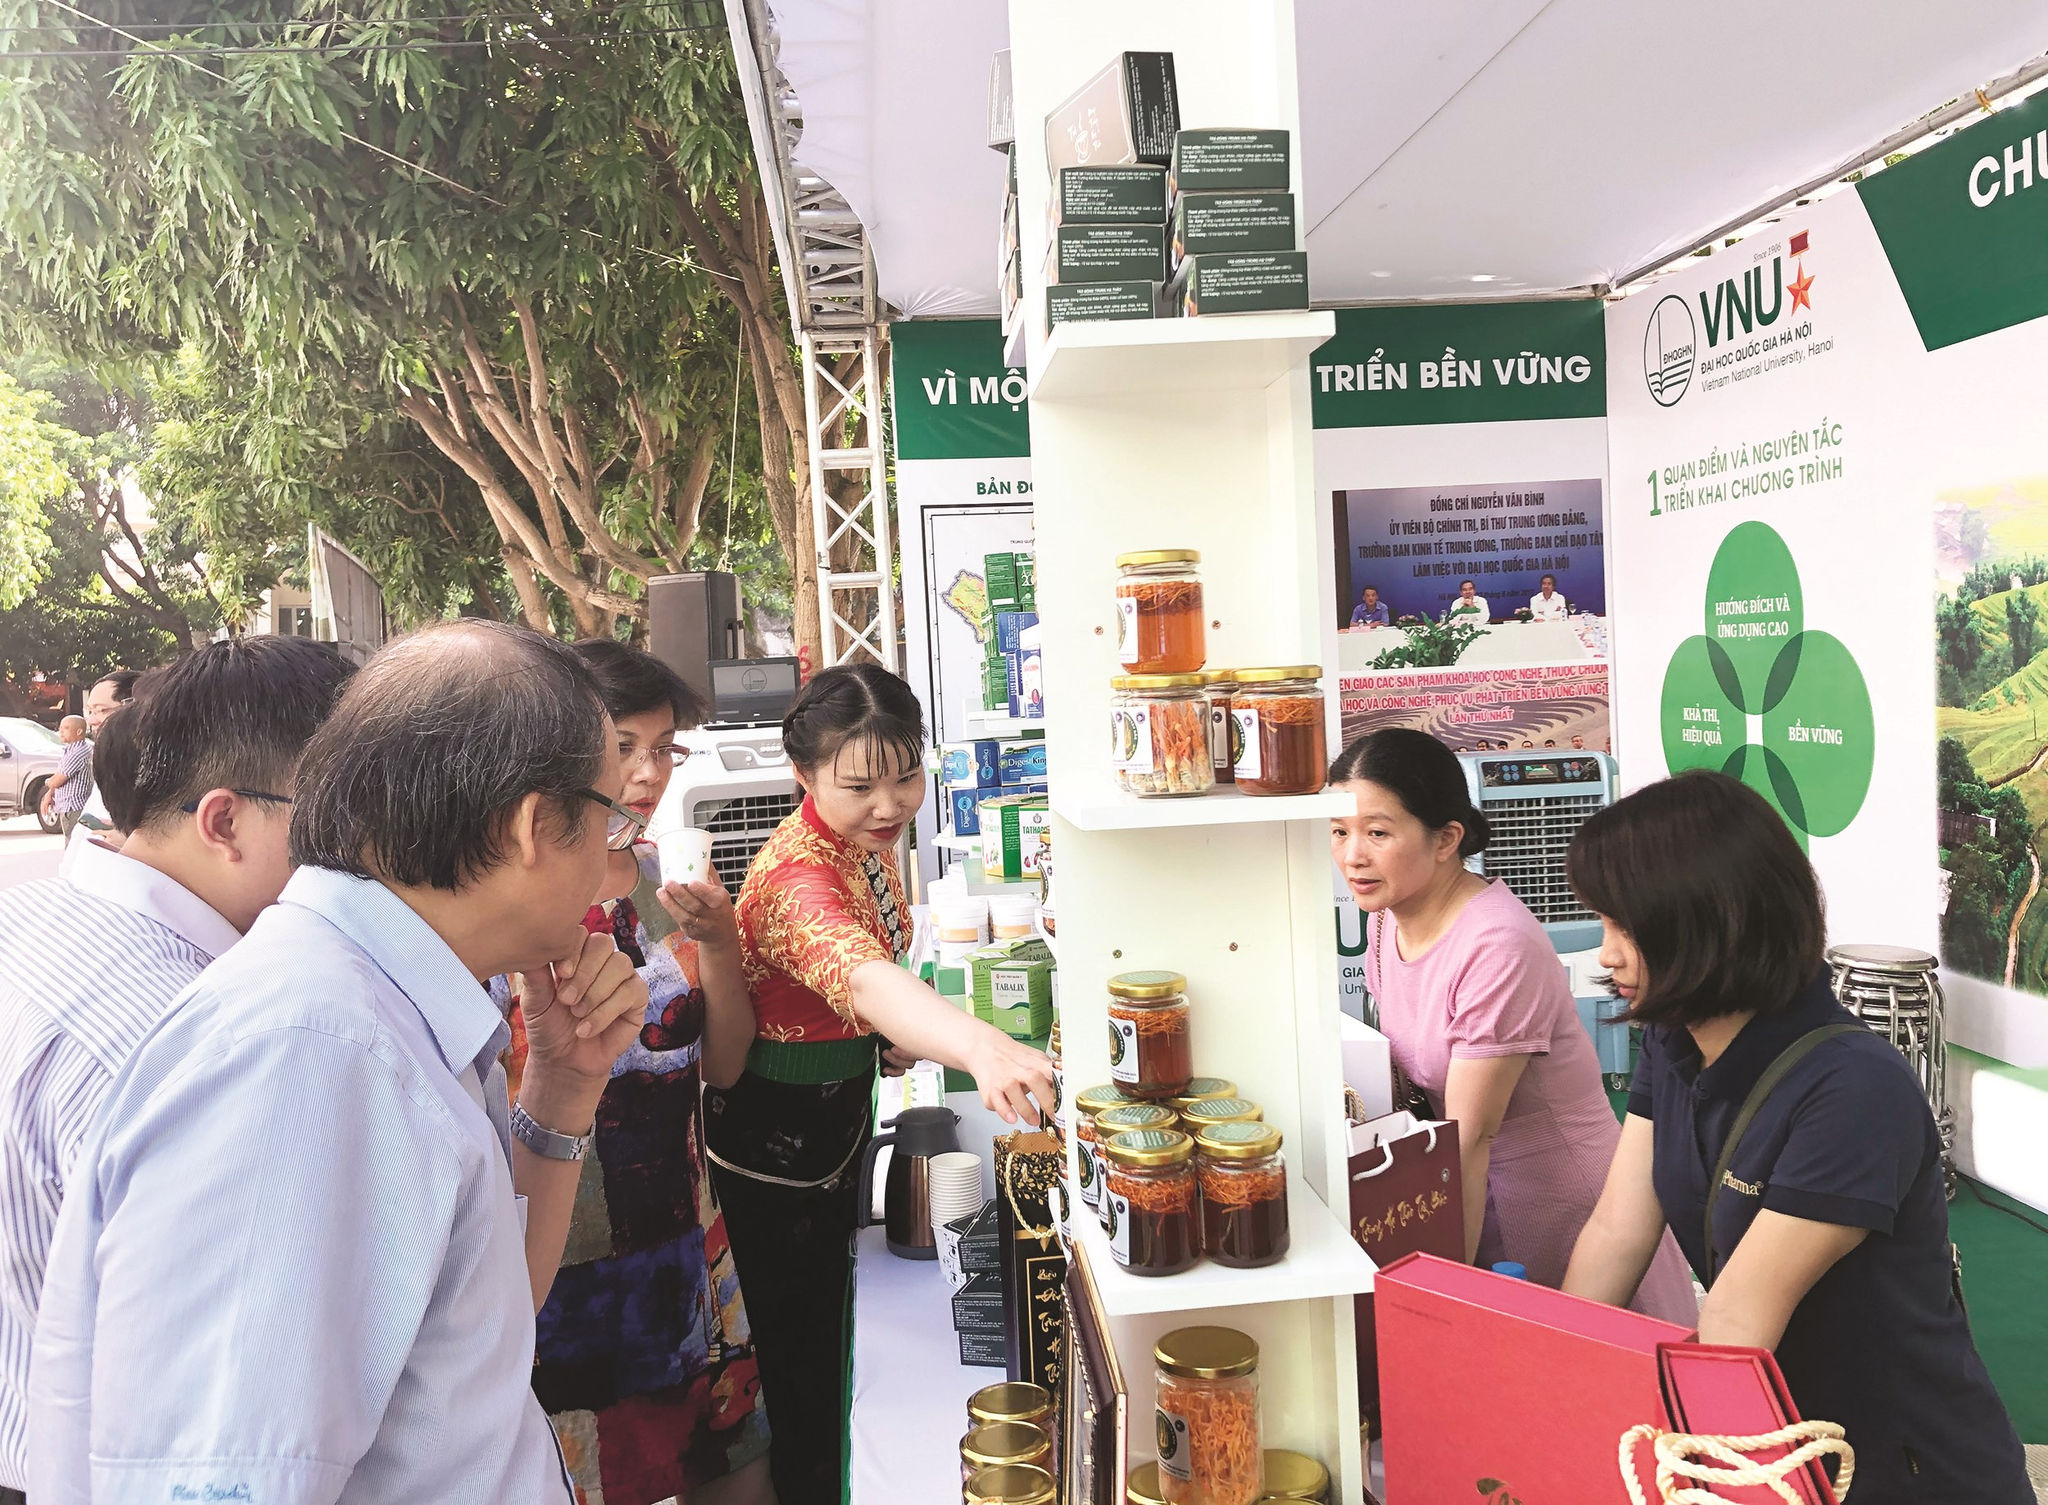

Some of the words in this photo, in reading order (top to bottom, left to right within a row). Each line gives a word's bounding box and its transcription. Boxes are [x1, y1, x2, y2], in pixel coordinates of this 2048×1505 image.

[1699, 256, 1782, 348] VNU
[1663, 344, 1692, 364] ĐHQGHN
[1700, 361, 1714, 375] ĐẠI
[1716, 354, 1734, 370] HỌC
[1735, 340, 1760, 362] QUỐC
[1762, 336, 1778, 351] GIA
[1780, 330, 1793, 346] HÀ
[1795, 321, 1812, 342] NỘI
[1316, 348, 1407, 392] TRIỂN
[1420, 346, 1481, 389] BỀN
[1493, 350, 1591, 386] VỮNG
[1701, 374, 1729, 392] Vietnam
[1731, 365, 1762, 382] National
[1763, 349, 1805, 371] University,
[1808, 336, 1834, 356] Hanoi
[921, 368, 957, 405] VÌ
[1664, 461, 1696, 486] QUAN
[1699, 446, 1727, 478] ĐIỂM
[1731, 442, 1749, 469] VÀ
[1752, 430, 1808, 464] NGUYÊN
[1812, 416, 1843, 450] TẮC
[976, 476, 1011, 495] BẢN
[1647, 469, 1662, 516] 1
[1664, 482, 1694, 512] TRIỂN
[1698, 482, 1726, 506] KHAI
[1731, 467, 1794, 500] CHƯƠNG
[1799, 455, 1843, 486] TRÌNH
[1455, 494, 1469, 510] CHÍ
[1508, 515, 1535, 530] TRUNG
[1393, 545, 1410, 557] BAN
[1412, 543, 1432, 556] KINH
[1445, 541, 1472, 554] TRUNG
[1535, 536, 1552, 549] BAN
[1525, 557, 1539, 571] GIA
[1715, 596, 1748, 616] HƯỚNG
[1749, 595, 1775, 614] ĐÍCH
[1776, 592, 1791, 612] VÀ
[1717, 619, 1738, 638] ỨNG
[1738, 622, 1766, 641] DỤNG
[1768, 620, 1789, 636] CAO
[1353, 677, 1374, 690] GIAO
[1446, 672, 1470, 684] KHOA
[1366, 694, 1379, 710] VÀ
[1381, 693, 1406, 709] CÔNG
[1683, 703, 1701, 721] KHẢ
[1682, 725, 1702, 746] HIỆU
[1703, 725, 1723, 746] QUẢ
[1788, 718, 1809, 742] BỀN
[1810, 724, 1843, 745] VỮNG
[1342, 966, 1366, 978] GIA
[995, 982, 1025, 991] TABALIX
